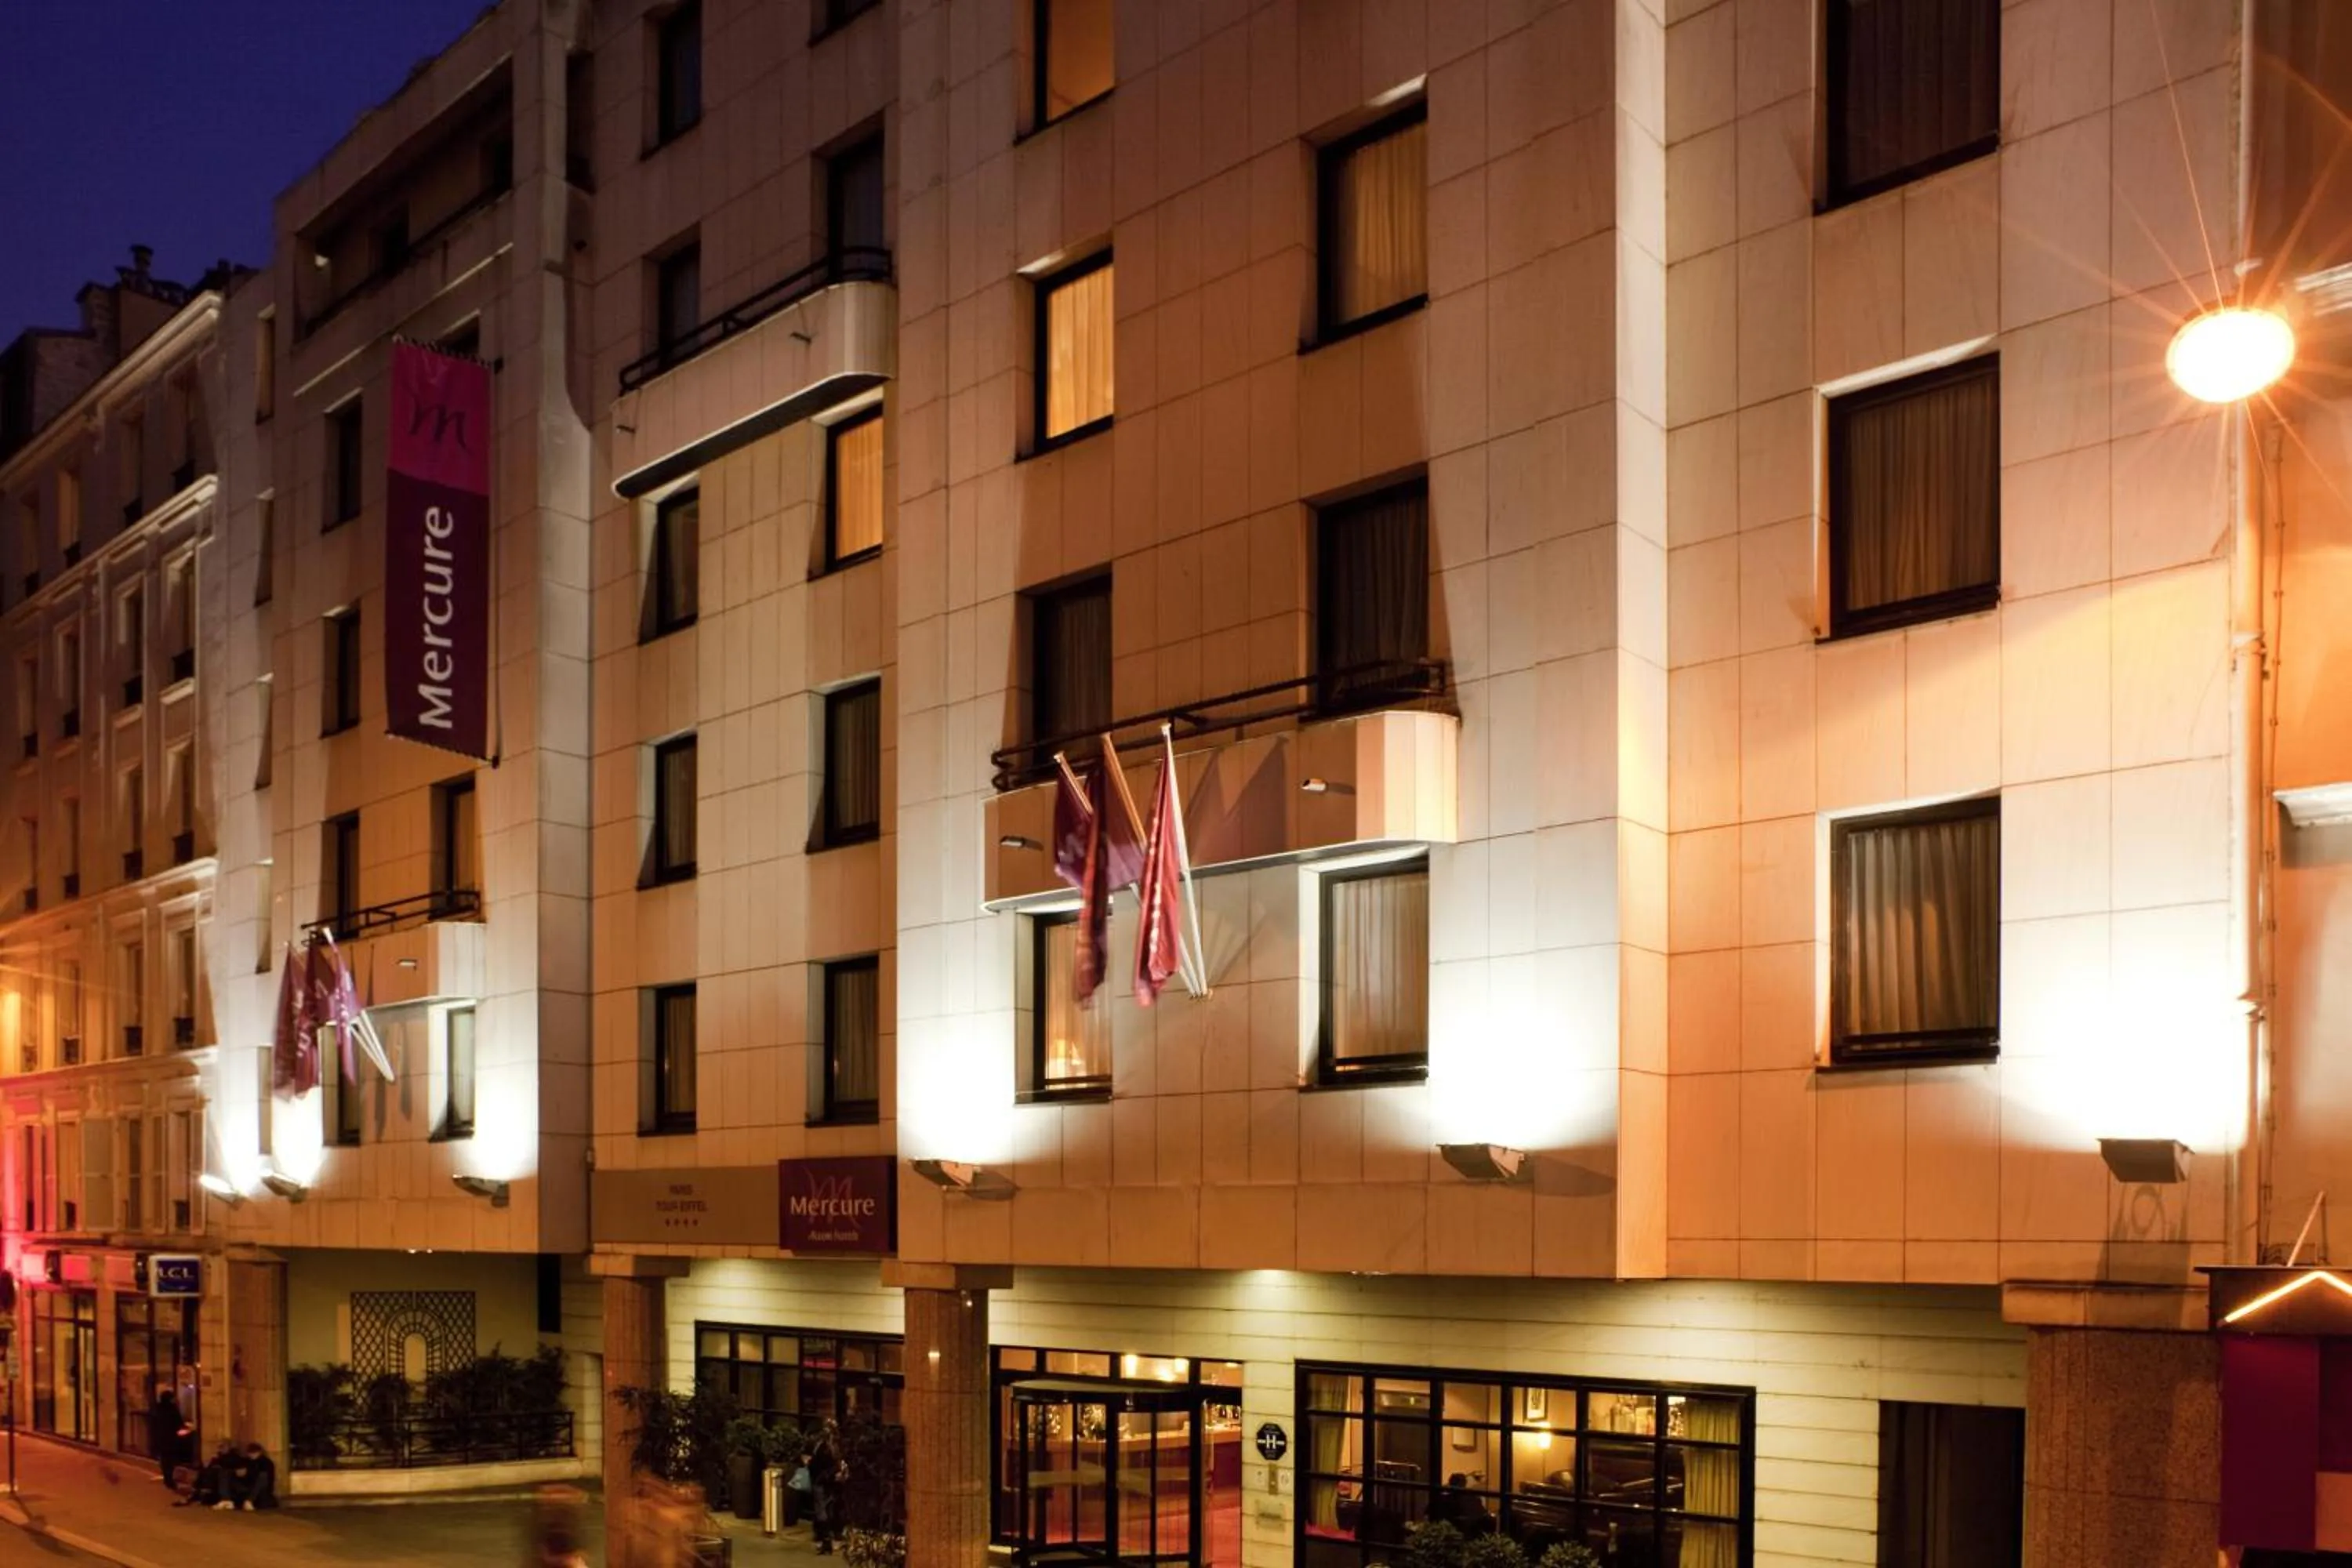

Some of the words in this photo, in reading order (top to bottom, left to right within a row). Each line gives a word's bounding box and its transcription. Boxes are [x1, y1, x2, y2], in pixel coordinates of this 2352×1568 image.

[418, 506, 453, 729] Mercure
[790, 1196, 876, 1216] Mercure
[158, 1267, 194, 1279] LCL
